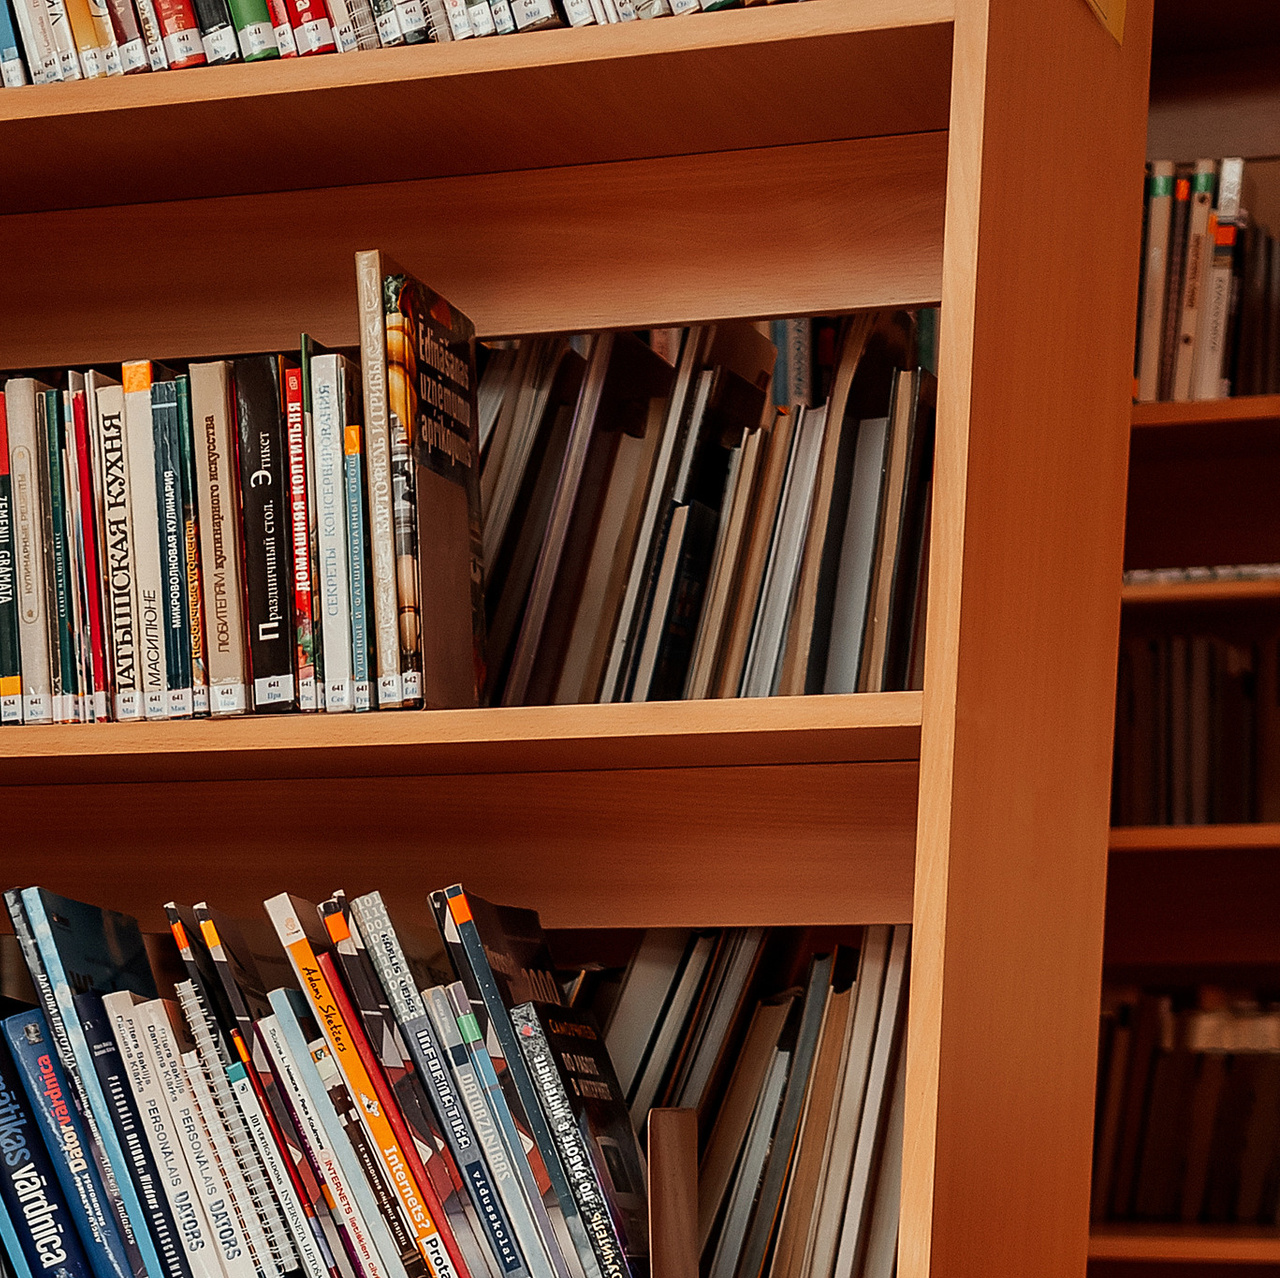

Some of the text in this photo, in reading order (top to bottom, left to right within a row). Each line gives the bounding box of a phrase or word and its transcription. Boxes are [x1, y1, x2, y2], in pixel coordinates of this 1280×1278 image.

[101, 410, 126, 509] КУХНЯ
[203, 414, 220, 481] искусства
[288, 400, 311, 591] ДОМАШНЯЯ КОПТИЛЬНЯ
[163, 469, 182, 628] МИКРОВОЛНОВАЯ КУЛИНАРИЯ
[324, 547, 339, 615] СЕКРЕТЫ
[249, 1113, 261, 1128] 101
[7, 1159, 76, 1269] vārdnīca
[144, 1097, 206, 1253] PERSONĀLAIS DATORS
[178, 1107, 242, 1261] PERSONĀLAIS DATORS
[324, 1159, 353, 1215] INTERNETS
[380, 1143, 433, 1232] Internets?
[471, 1169, 516, 1264] vidusskolai
